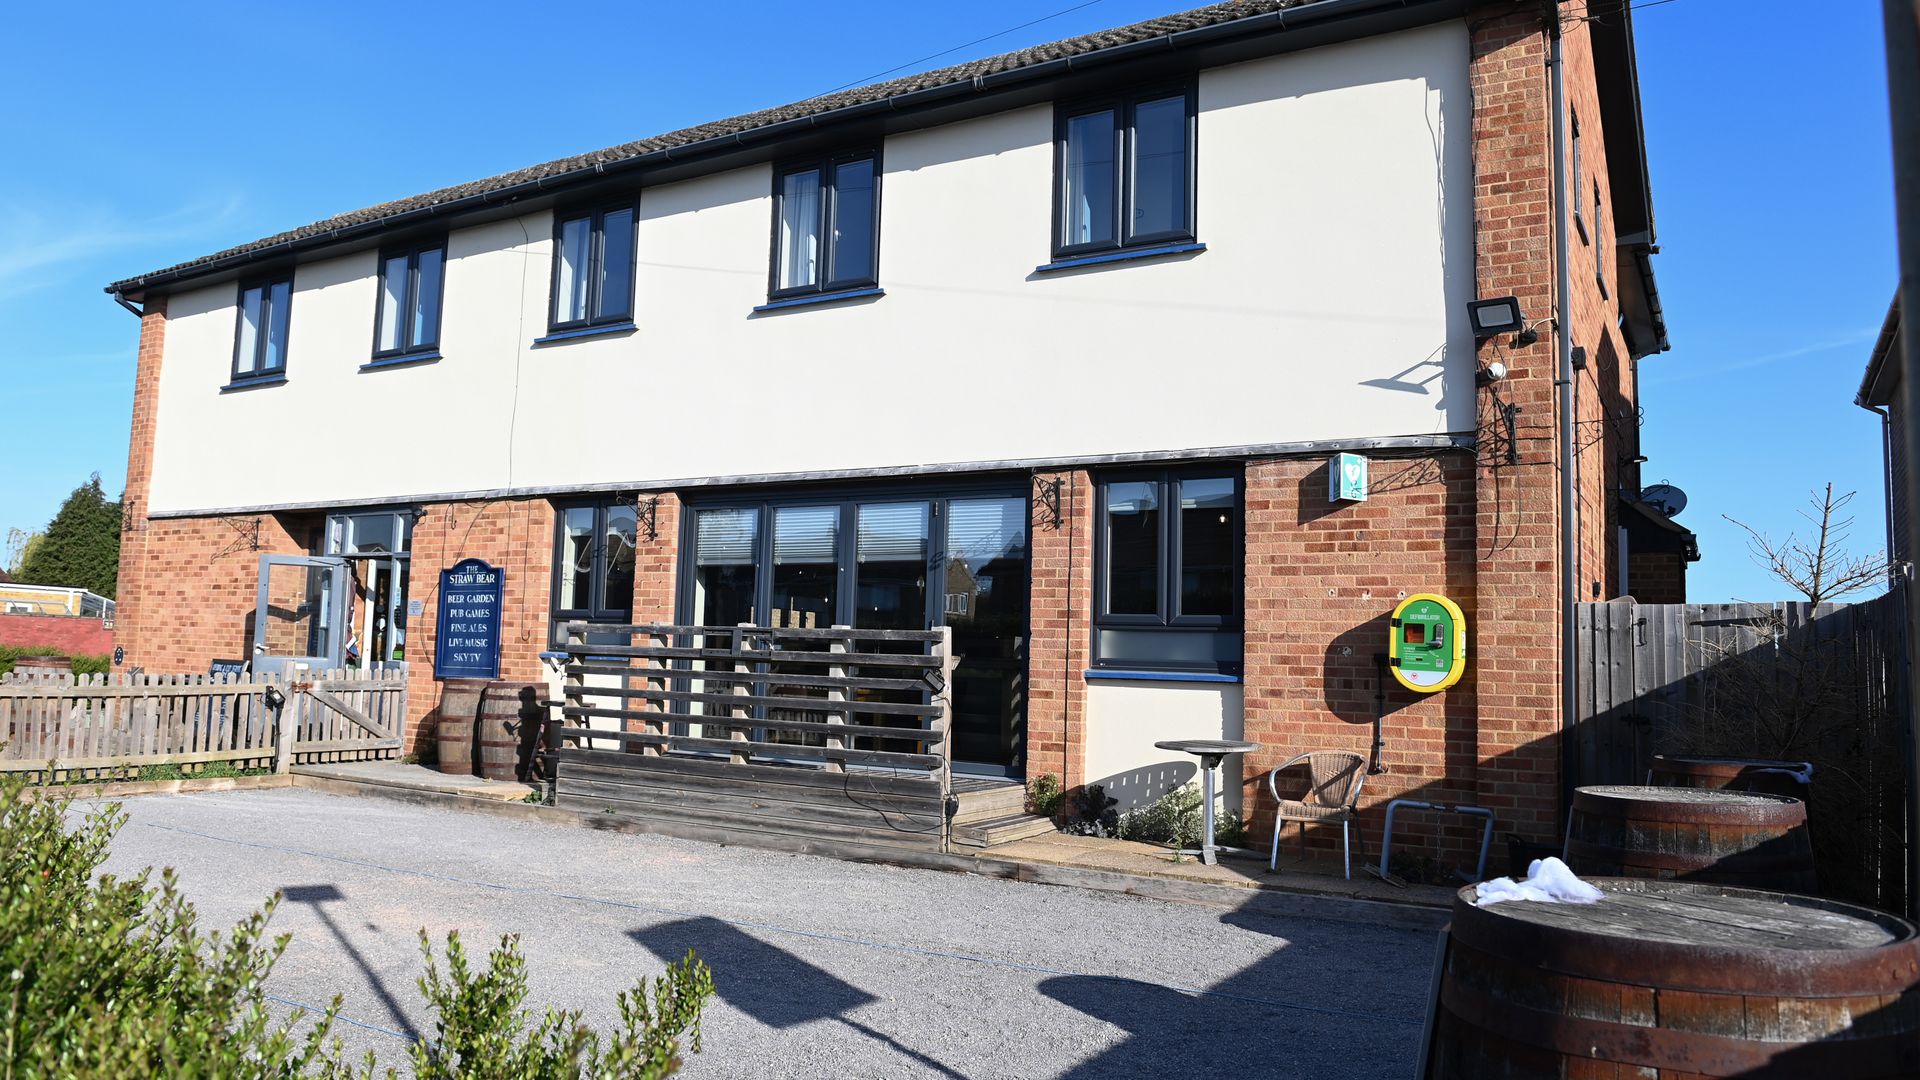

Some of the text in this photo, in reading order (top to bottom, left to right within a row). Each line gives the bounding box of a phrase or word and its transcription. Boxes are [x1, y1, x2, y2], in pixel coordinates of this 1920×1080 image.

[449, 574, 495, 583] STRAW BEAR
[448, 594, 495, 603] BEER GARDEN
[450, 609, 490, 618] PUB GAMES
[450, 623, 487, 632] FINE ALES
[448, 637, 488, 647] LIVE MUSIC
[453, 653, 482, 662] SKY TV
